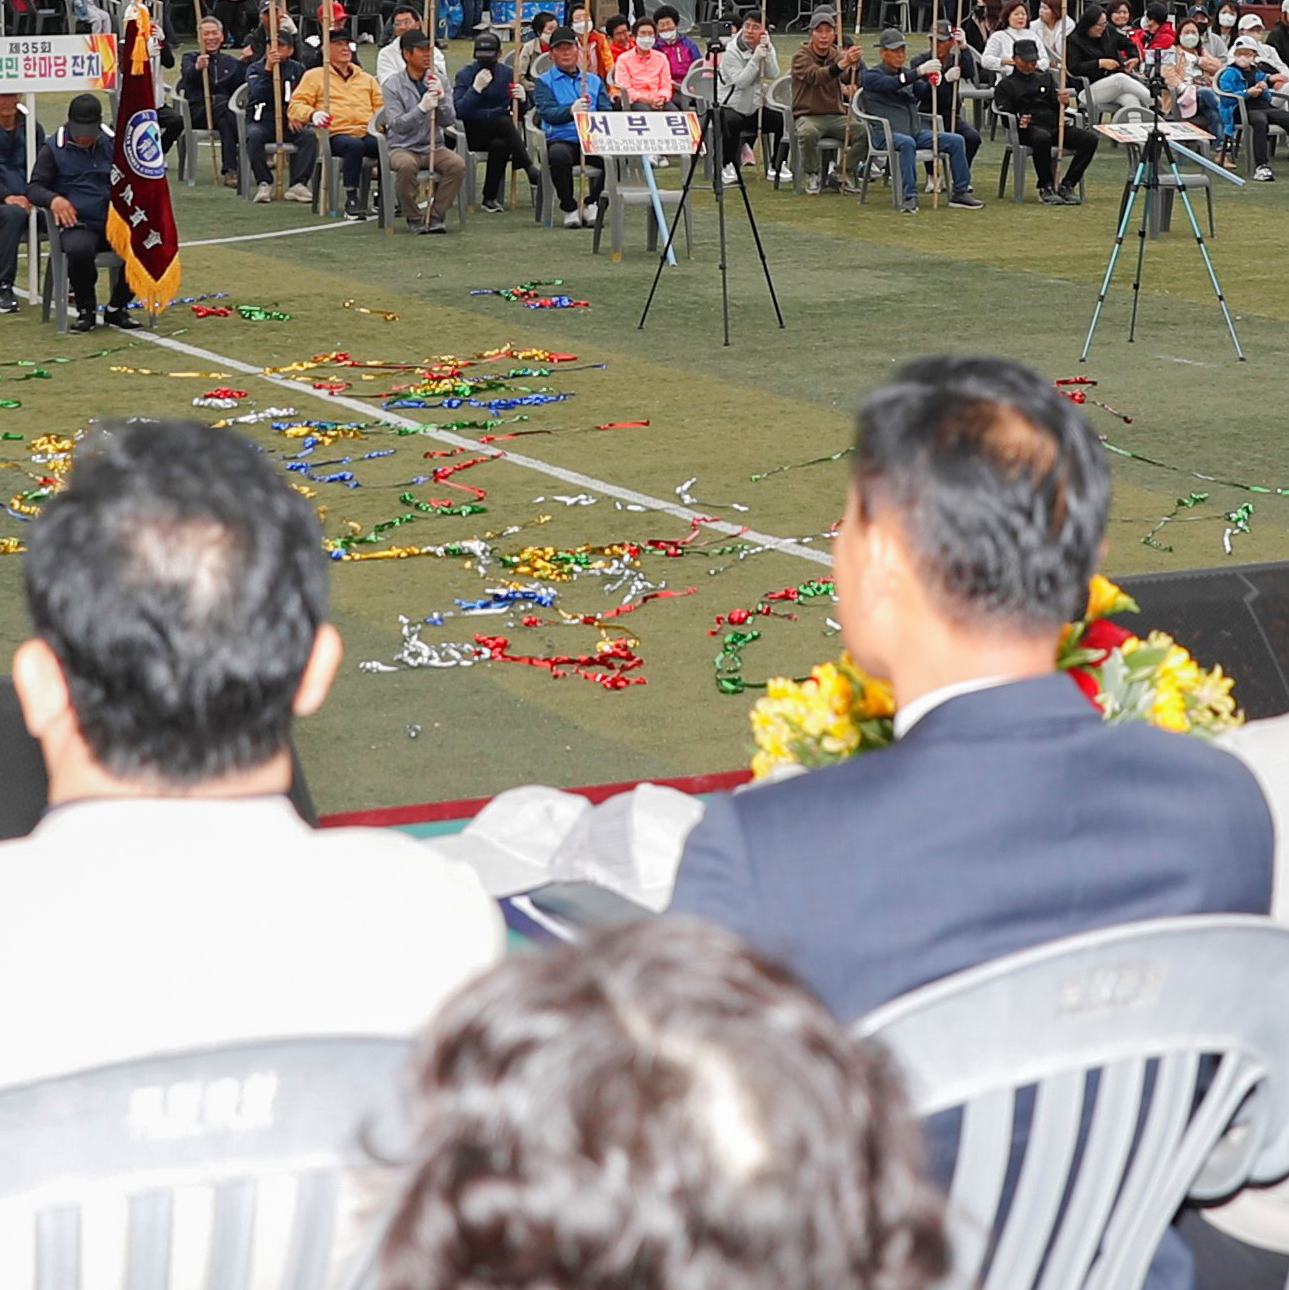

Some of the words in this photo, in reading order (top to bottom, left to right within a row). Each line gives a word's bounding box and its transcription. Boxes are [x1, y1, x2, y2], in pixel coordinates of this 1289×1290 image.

[9, 42, 52, 54] 제35회
[23, 56, 67, 78] 한마당
[72, 54, 100, 76] 잔치
